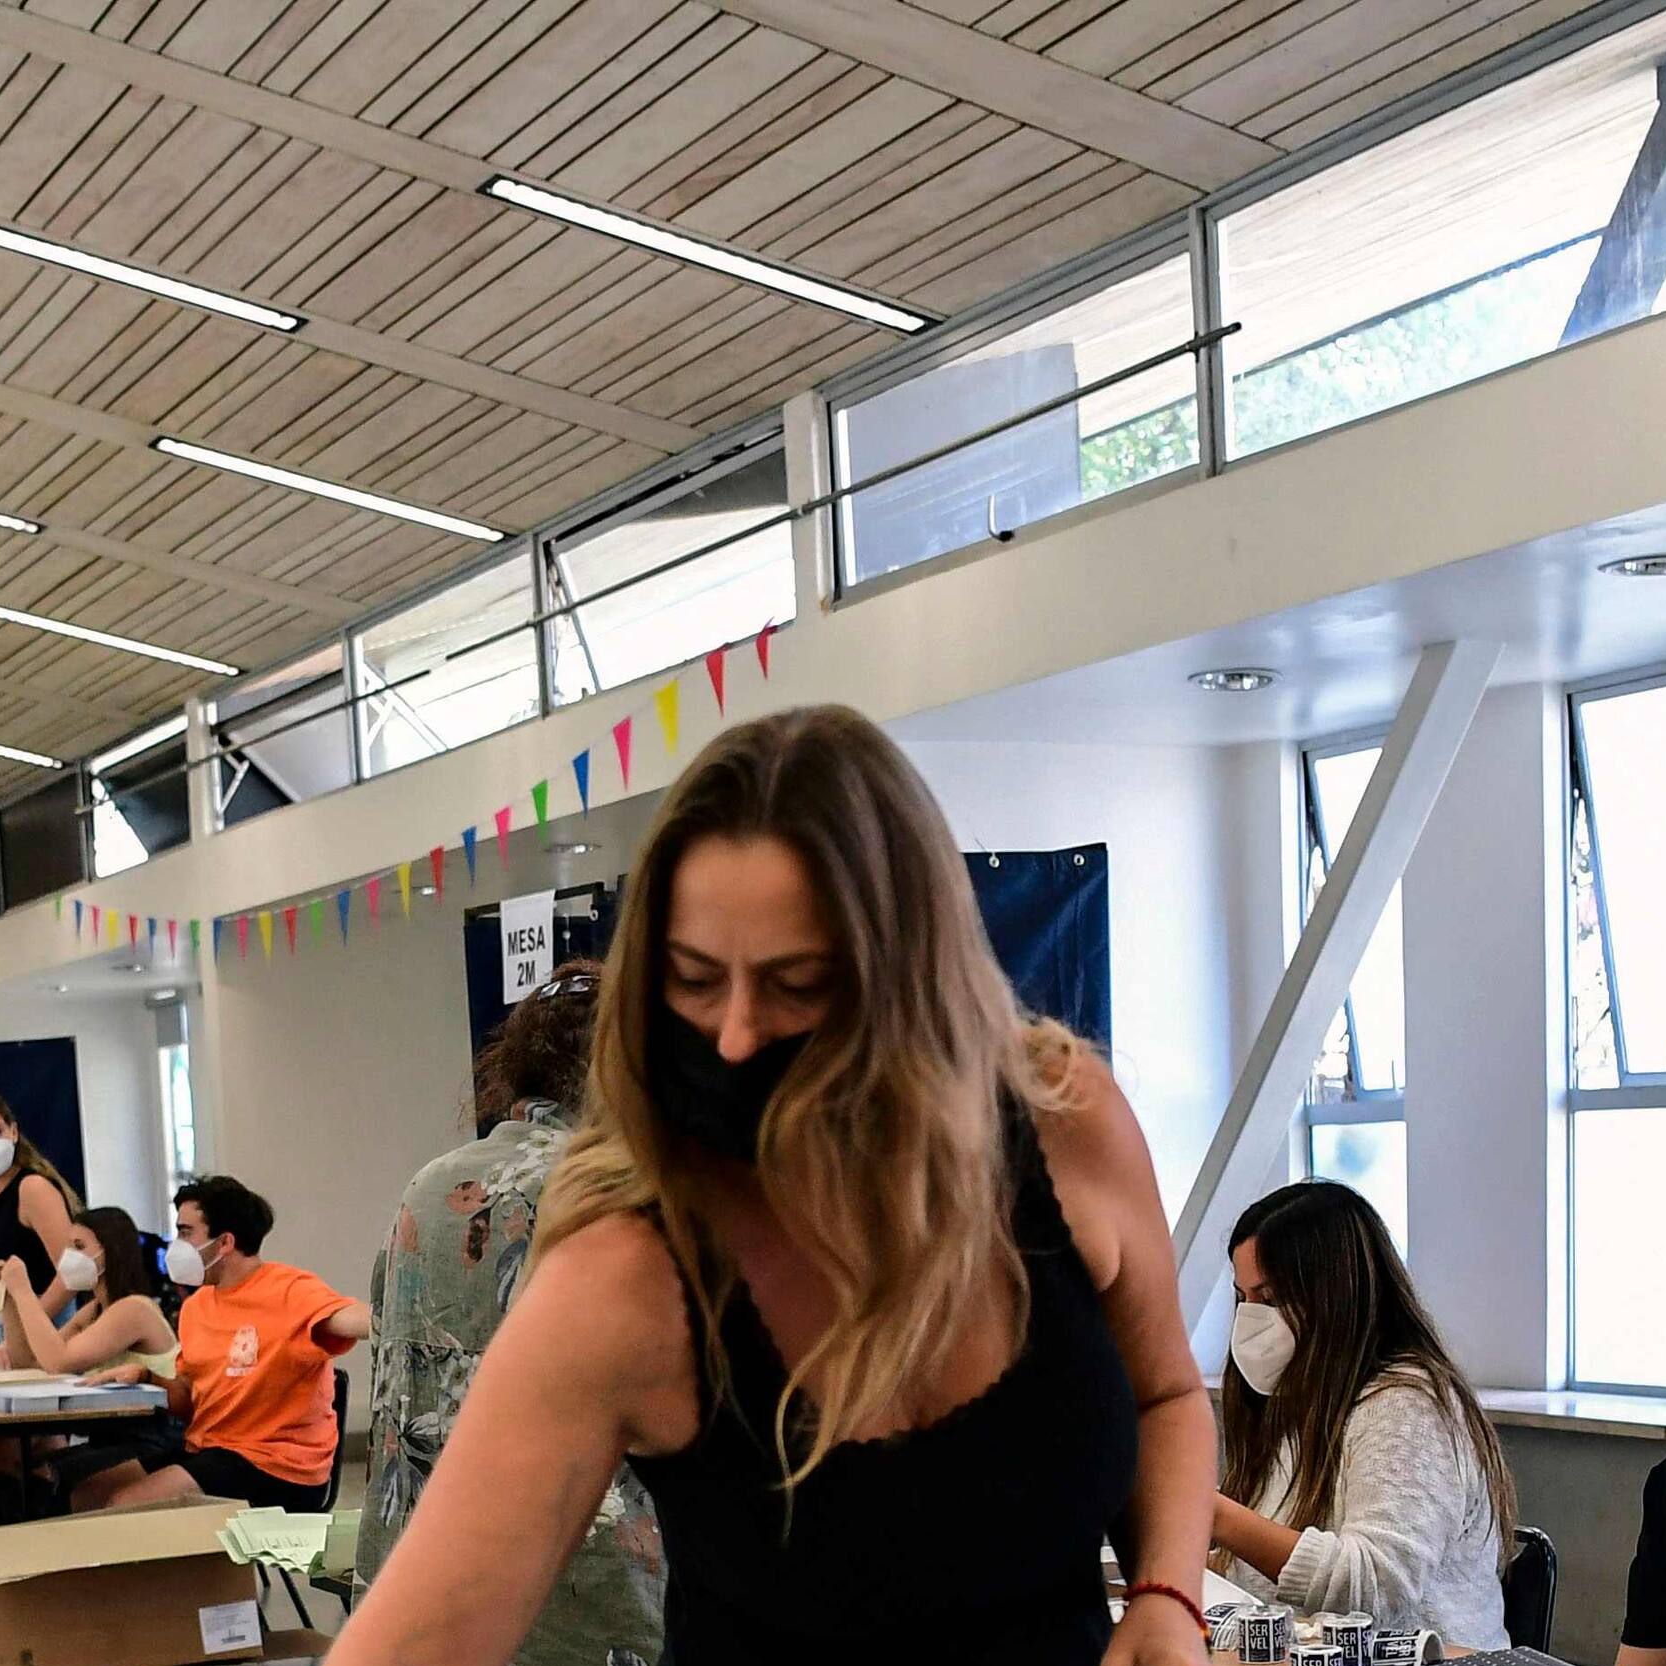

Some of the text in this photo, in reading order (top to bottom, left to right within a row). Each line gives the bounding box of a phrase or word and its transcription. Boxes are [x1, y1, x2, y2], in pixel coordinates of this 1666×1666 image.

[507, 925, 546, 957] MESA
[517, 960, 536, 987] 2M
[1250, 1623, 1268, 1636] SER
[1250, 1636, 1268, 1649] VEL
[1337, 1631, 1357, 1645] SER
